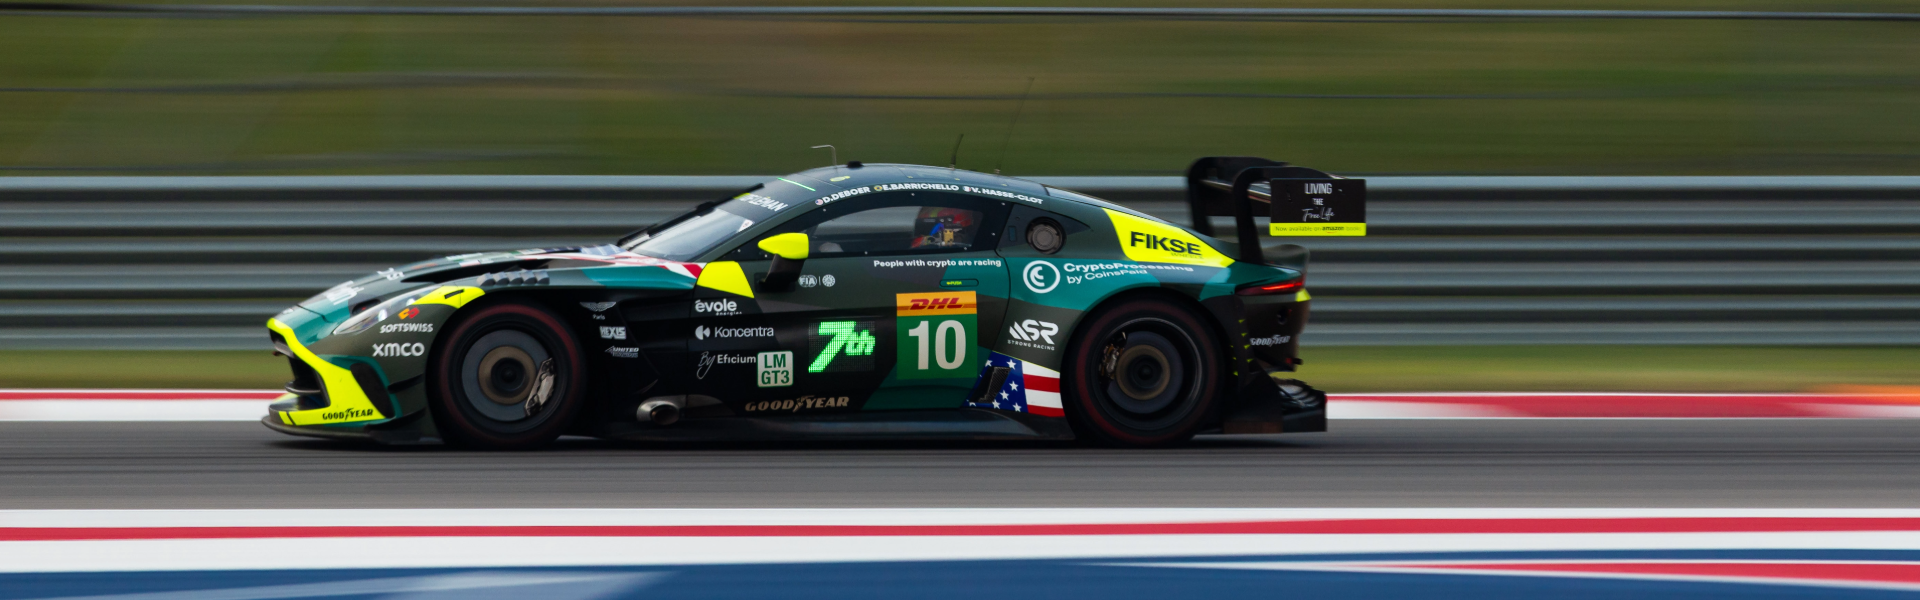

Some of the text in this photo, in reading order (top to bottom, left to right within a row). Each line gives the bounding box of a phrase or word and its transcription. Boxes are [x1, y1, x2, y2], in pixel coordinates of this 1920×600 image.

[882, 183, 959, 191] E.BARRICHELLO
[1305, 183, 1332, 194] LIVING
[822, 186, 871, 203] D.DEBOER
[1131, 231, 1202, 256] FIKSE
[874, 260, 904, 268] People
[906, 259, 925, 267] with
[927, 260, 956, 268] crypto
[974, 259, 1001, 267] racing
[1064, 262, 1194, 272] CryptoProcessing
[1066, 269, 1148, 284] by CoinsPaid
[910, 298, 962, 310] DHL
[380, 323, 433, 333] SOFTSWISS
[715, 326, 774, 338] Koncentra
[808, 321, 875, 373] 7th
[909, 320, 966, 370] 10
[717, 355, 756, 364] Eficium
[764, 353, 786, 369] LM
[761, 370, 790, 385] GT3
